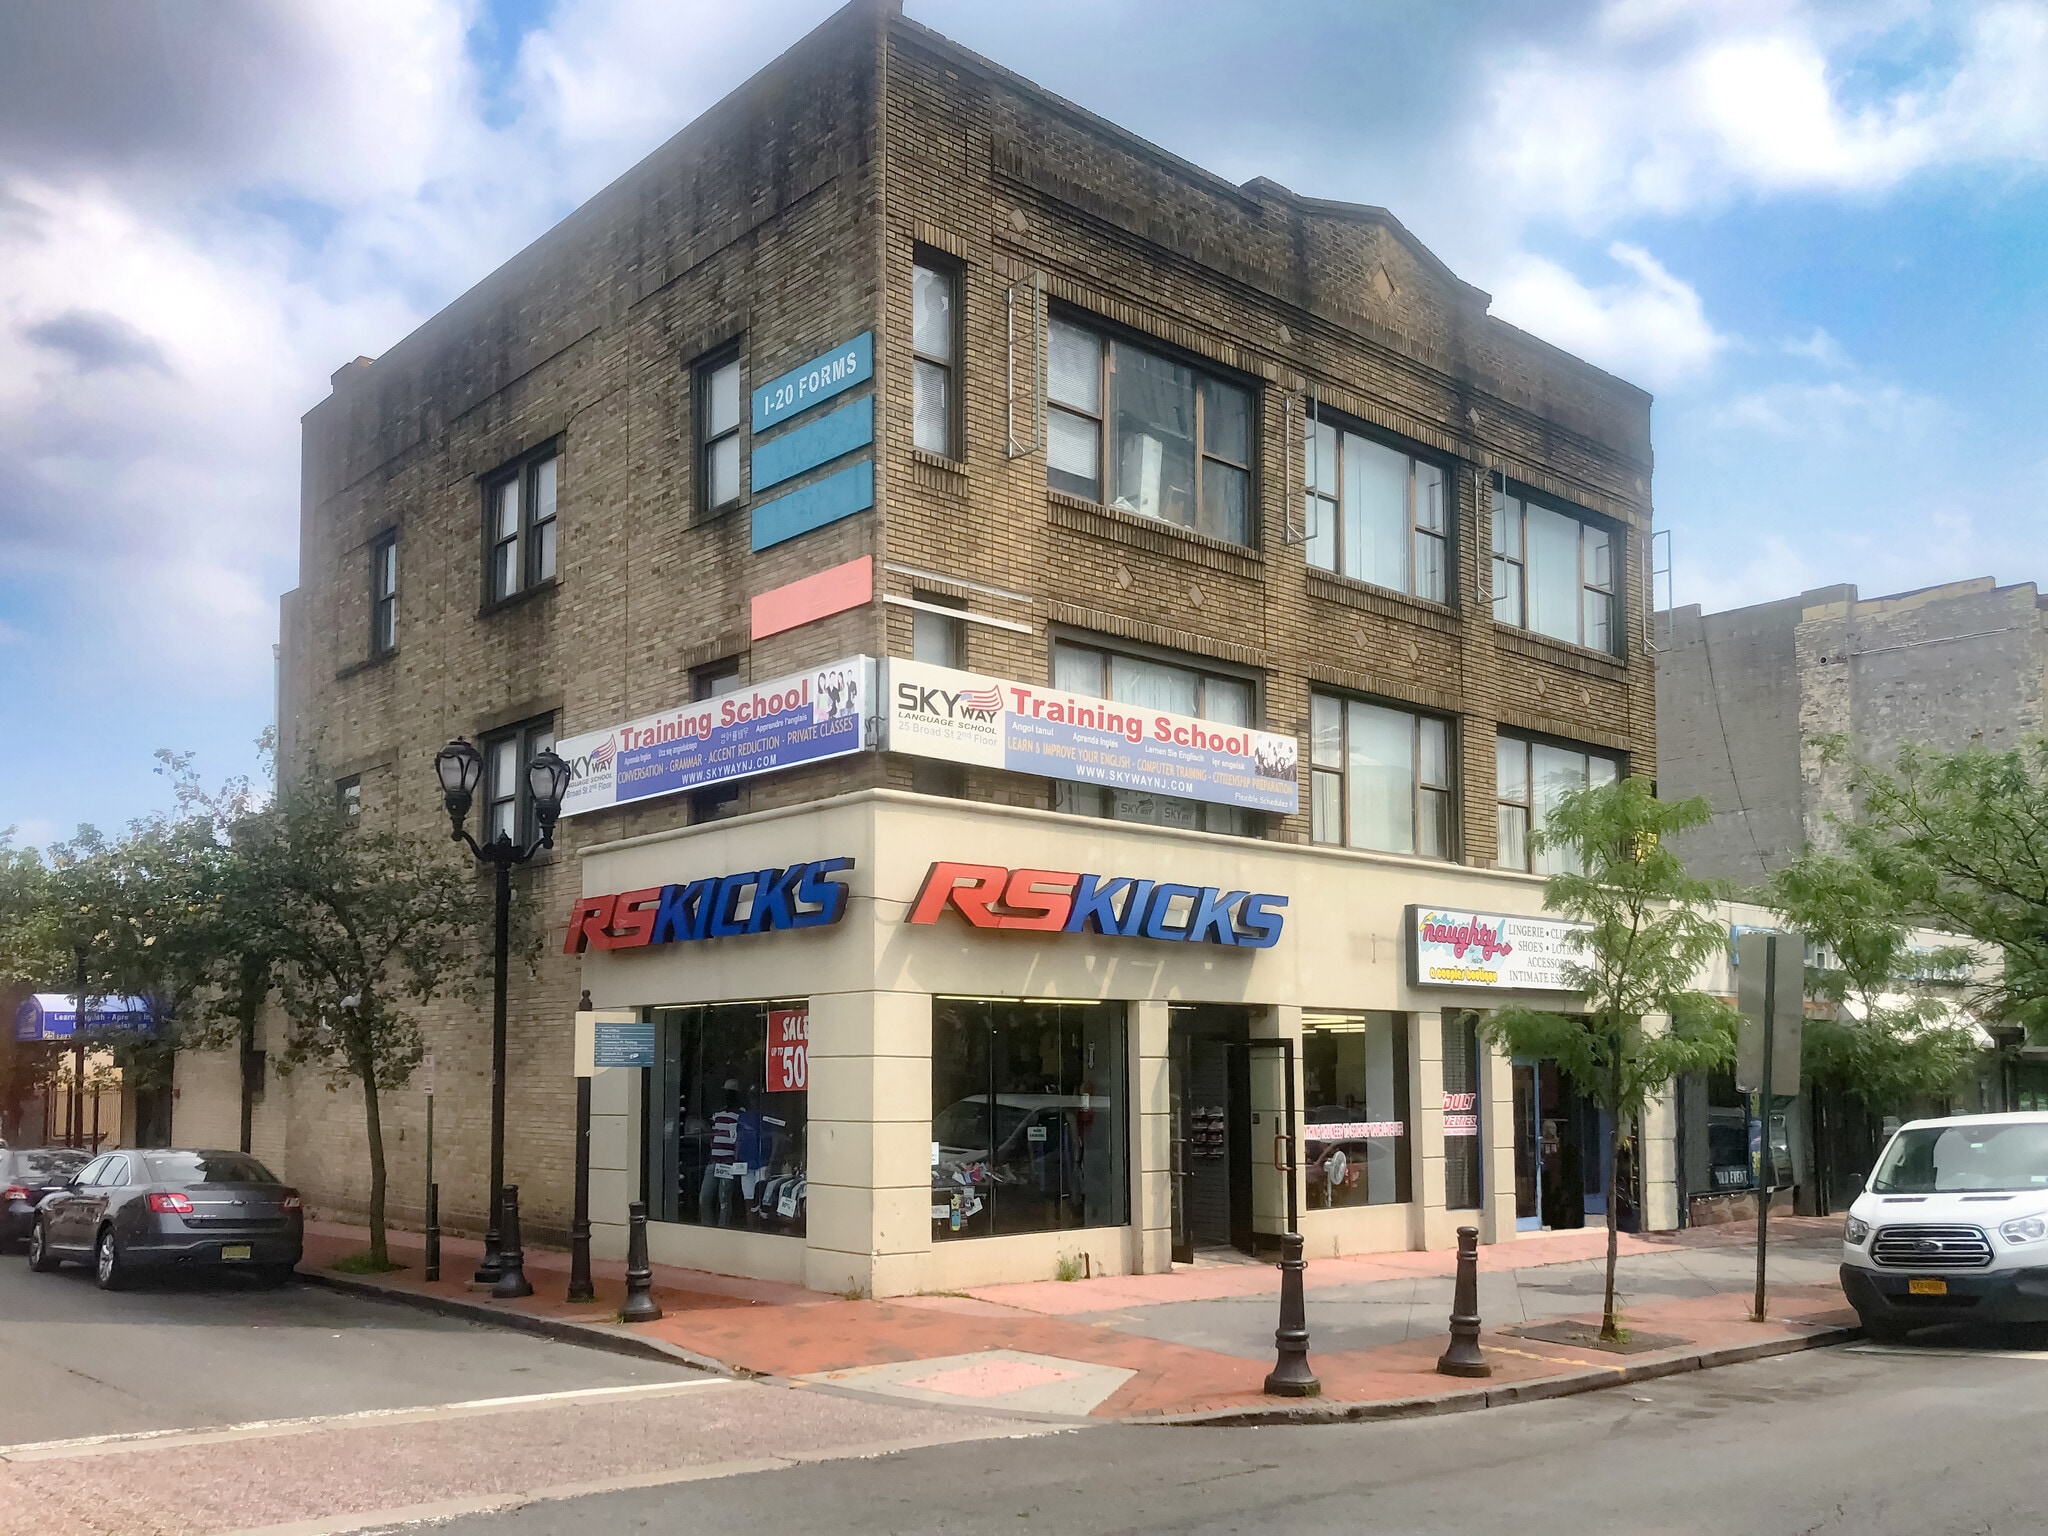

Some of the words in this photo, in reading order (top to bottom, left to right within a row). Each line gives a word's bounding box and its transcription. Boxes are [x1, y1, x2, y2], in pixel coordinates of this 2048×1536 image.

[764, 385, 793, 416] I-20
[799, 351, 857, 399] FORMS
[620, 713, 712, 752] Training
[720, 679, 808, 727] School
[755, 720, 783, 733] Apprendre
[898, 711, 954, 727] LANGUAGE
[958, 722, 997, 735] SCHOOL
[1010, 687, 1143, 743] Training
[1154, 717, 1249, 756] School
[899, 720, 910, 731] 25
[912, 723, 941, 736] Broad
[944, 729, 954, 739] St
[956, 731, 972, 741] 2nd
[974, 734, 998, 746] Floor
[1011, 721, 1034, 733] Angol
[1035, 726, 1054, 736] tanul
[1072, 732, 1099, 745] Aprenda
[617, 764, 664, 784] CONVERSATION
[669, 754, 702, 772] GRAMMAR
[708, 746, 735, 764] ACCENT
[737, 735, 780, 756] REDUCTION
[787, 725, 818, 745] PRIVATE
[820, 717, 853, 738] CLASSES
[1145, 744, 1167, 756] Lernen
[1167, 748, 1178, 758] Sie
[1178, 750, 1204, 763] Englisch
[590, 773, 612, 782] SCHOOL
[681, 754, 777, 785] WWW.SKYWAYNJ.COM
[1007, 736, 1033, 752] LEARN
[1043, 742, 1076, 760] IMPROVE
[1077, 748, 1099, 763] YOUR
[1100, 751, 1131, 769] ENGLISH
[1137, 758, 1175, 776] COMPUTER
[1176, 764, 1206, 781] TRAINING
[1213, 771, 1251, 788] CITIZENSHIP
[1252, 777, 1293, 795] PREPARATION
[566, 788, 581, 798] Broad
[598, 782, 612, 790] Floor
[1076, 764, 1193, 792] WWW.SKYWAYNJ.COM
[1234, 792, 1258, 803] Flexible
[1423, 916, 1498, 961] naughty
[1508, 924, 1545, 938] LINGERIE
[1429, 967, 1435, 979] a
[1465, 966, 1498, 985] boutique
[1509, 970, 1549, 983] INTIMATE
[783, 1016, 809, 1041] SALE
[771, 1047, 777, 1056] UP
[777, 1047, 783, 1056] TO
[783, 1045, 808, 1088] 50
